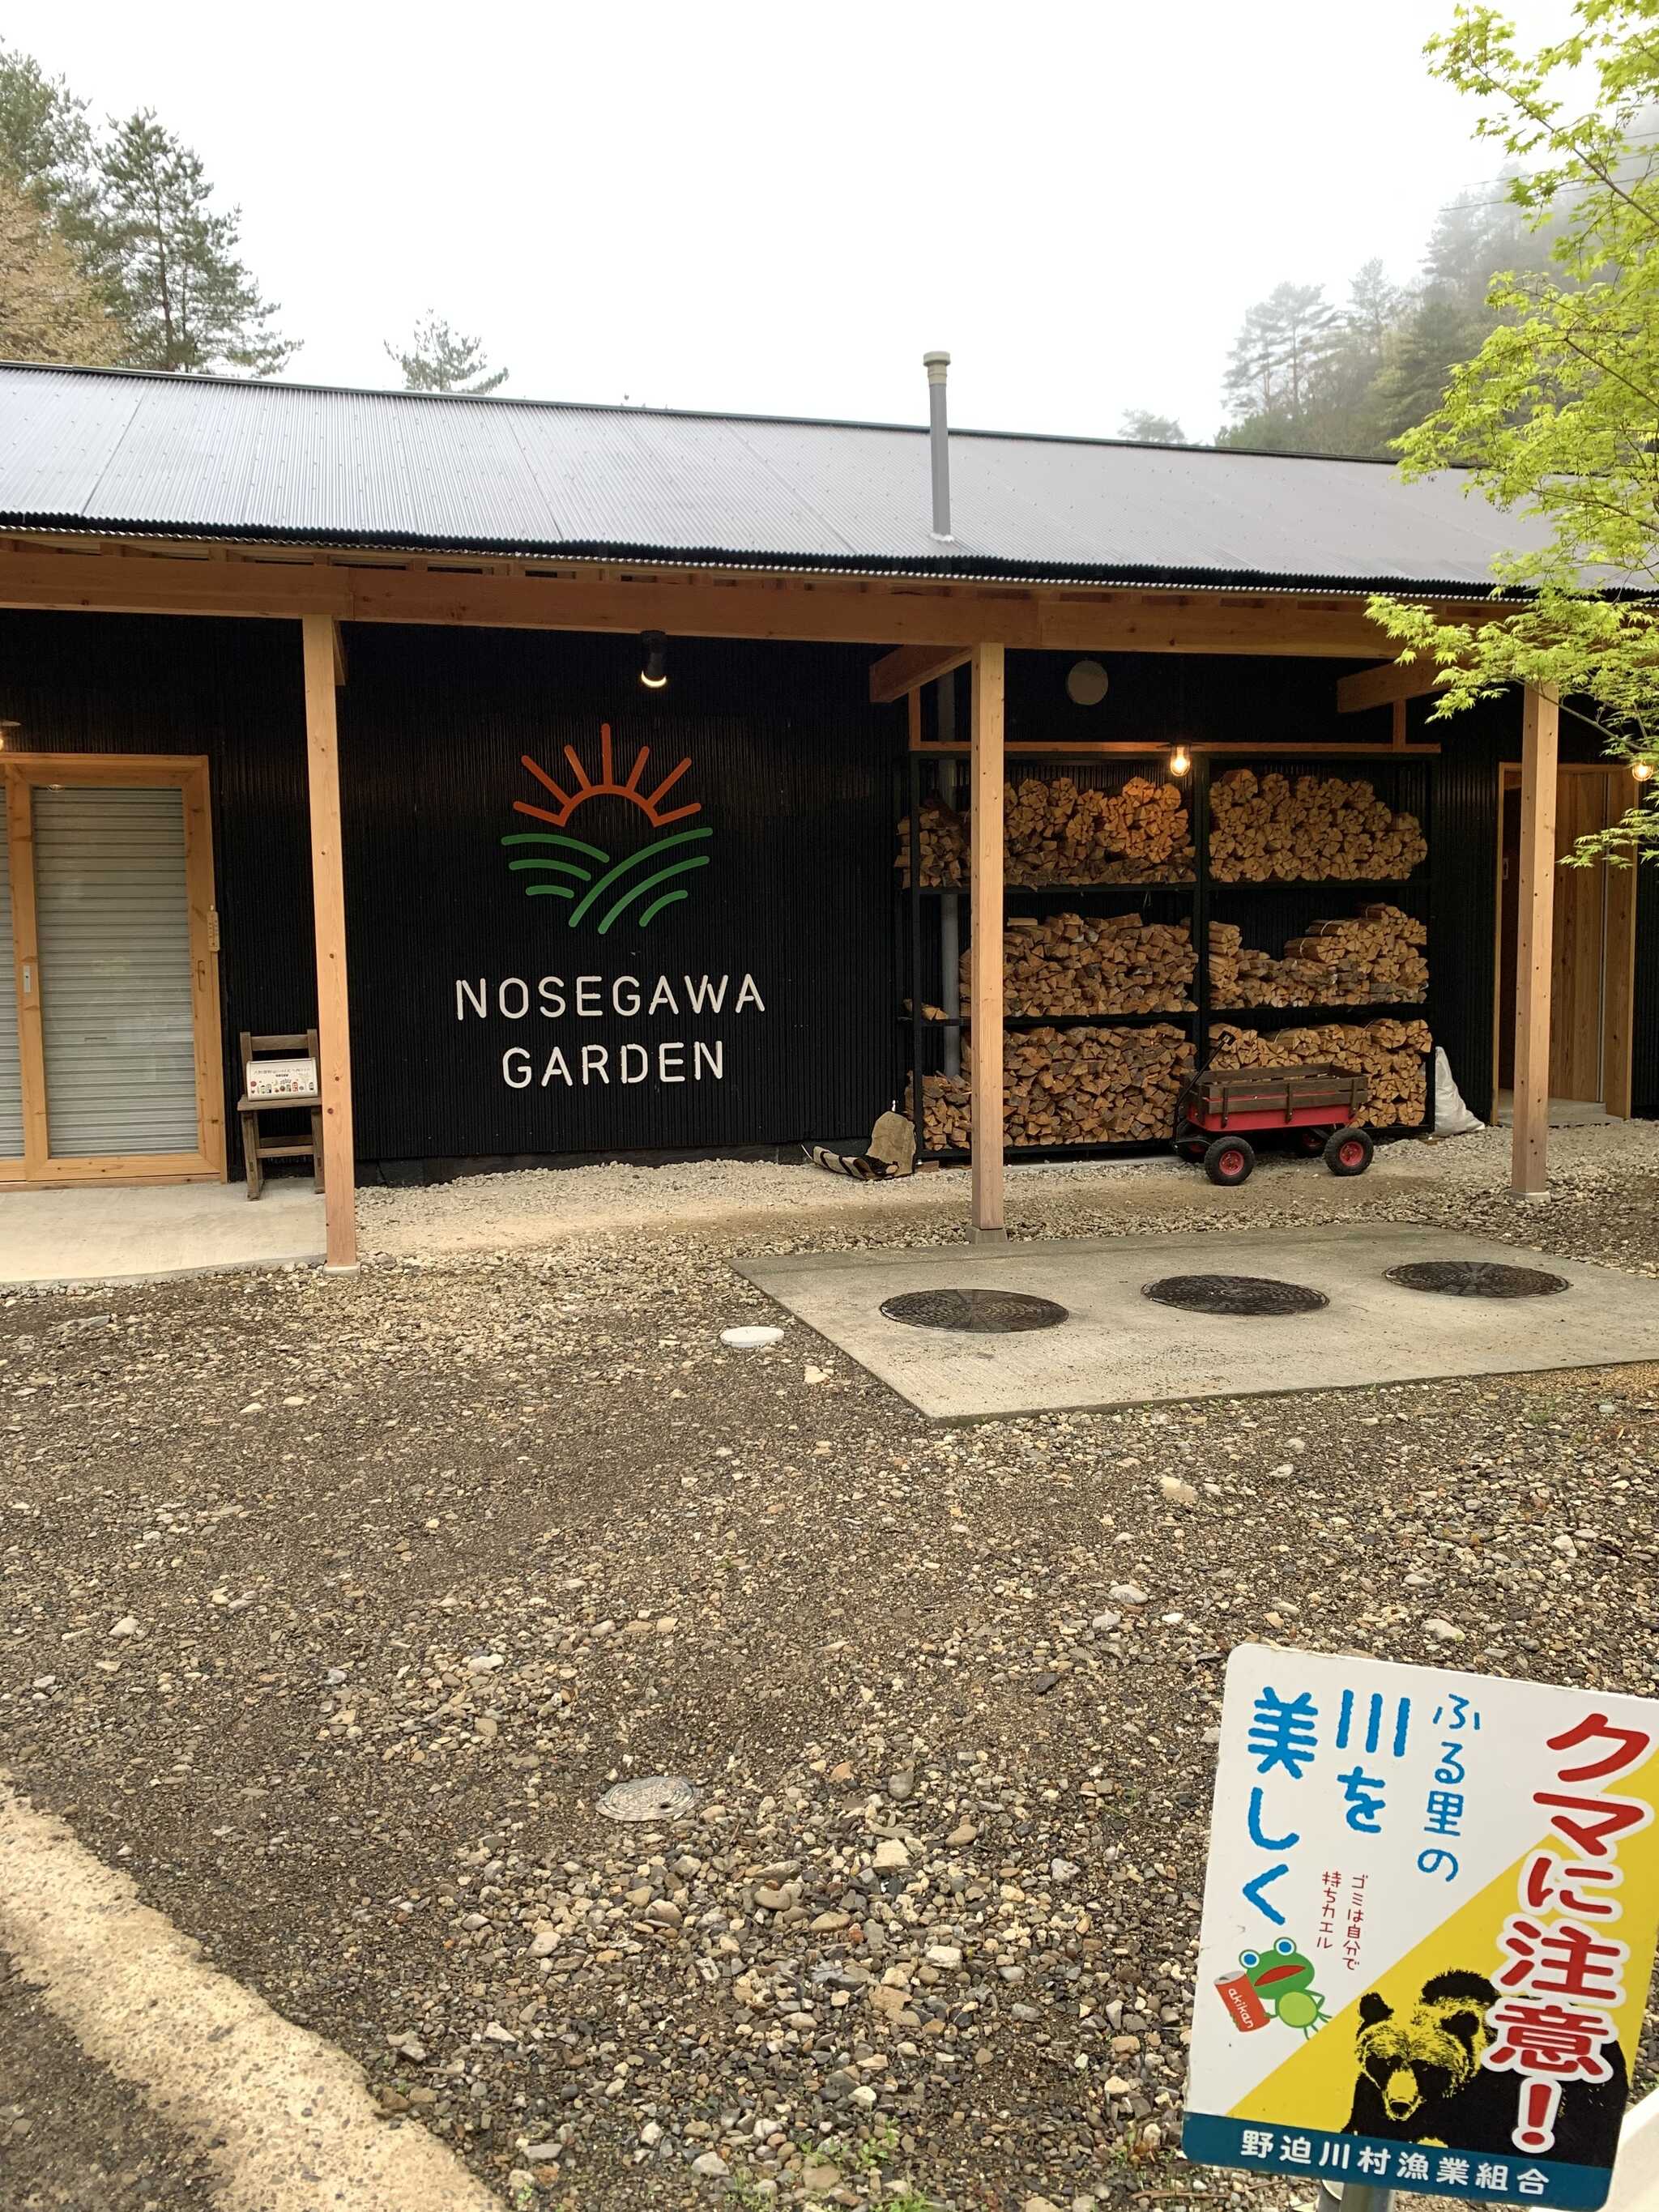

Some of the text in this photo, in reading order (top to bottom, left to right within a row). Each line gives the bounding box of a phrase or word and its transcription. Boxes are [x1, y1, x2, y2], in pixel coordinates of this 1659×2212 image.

[456, 974, 766, 1021] NOSEGAWA
[502, 1041, 723, 1089] GARDEN
[1243, 1686, 1319, 1926] 美しく
[1337, 1690, 1410, 1834] 川を
[1418, 1694, 1481, 1882] ふる里の
[1316, 1870, 1341, 1949] 持ちカエル
[1342, 1873, 1367, 1971] ゴミは自分で
[1489, 1713, 1650, 2146] クマに注意!
[1228, 1988, 1254, 2028] akikan
[1241, 2129, 1549, 2195] 野迫川村漁業組合
